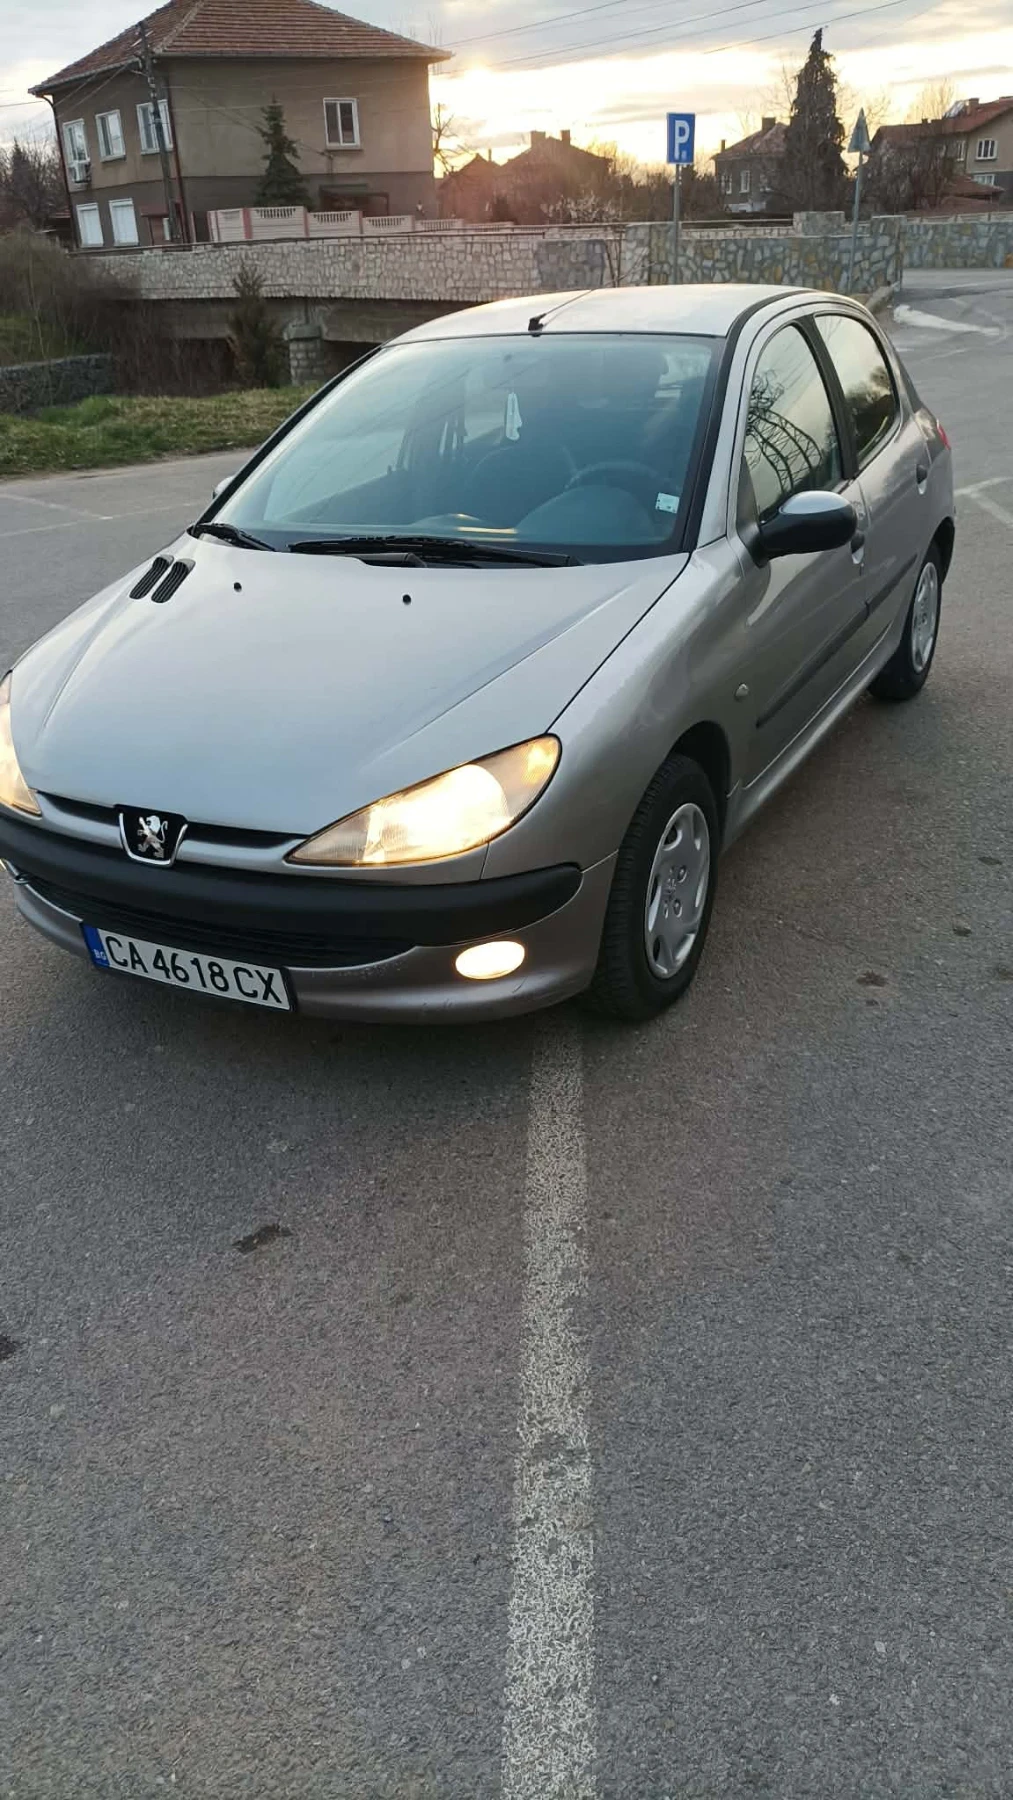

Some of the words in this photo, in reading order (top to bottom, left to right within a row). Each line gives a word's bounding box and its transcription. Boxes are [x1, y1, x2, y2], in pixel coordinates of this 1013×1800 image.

[93, 948, 107, 961] BG
[105, 936, 148, 973] CA
[152, 948, 230, 992] 4618
[232, 966, 282, 1004] CX
